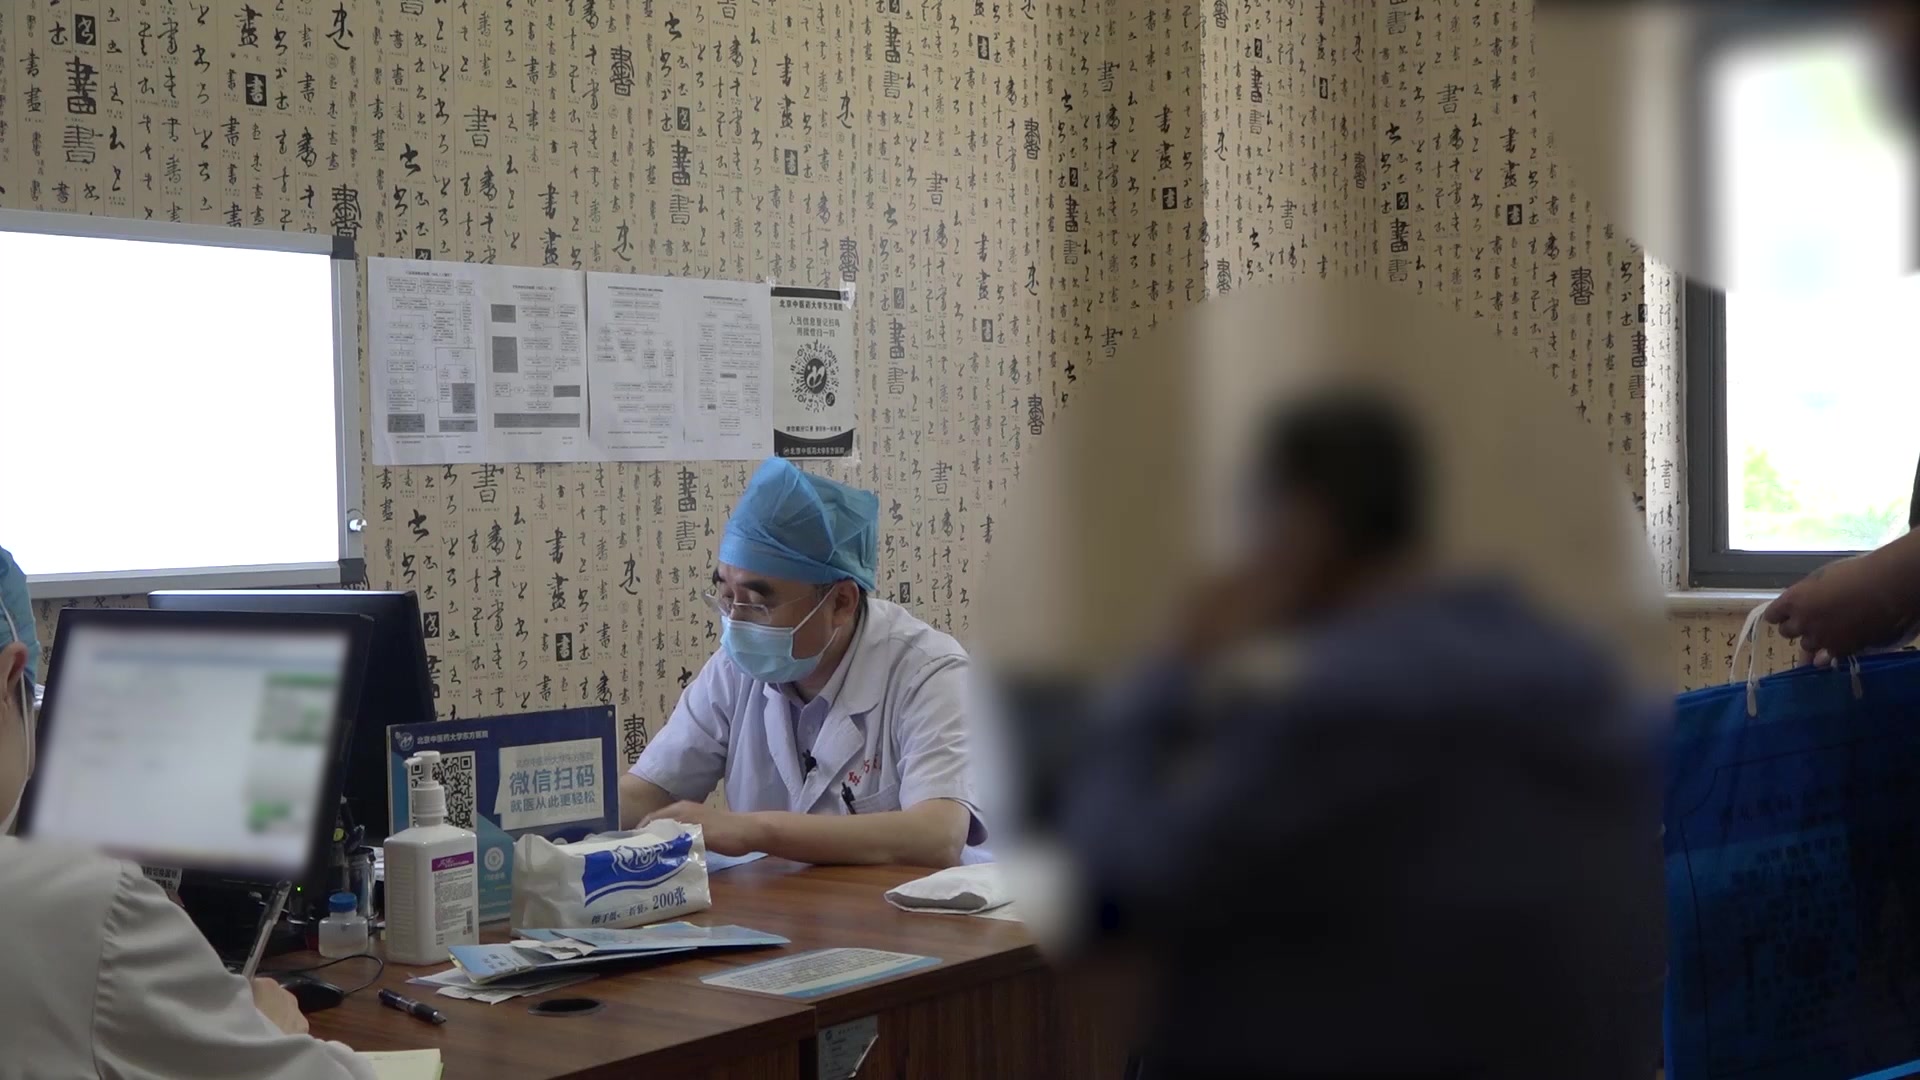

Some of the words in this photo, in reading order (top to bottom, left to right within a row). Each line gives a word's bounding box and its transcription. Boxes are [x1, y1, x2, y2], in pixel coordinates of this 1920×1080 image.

[509, 764, 595, 796] 微信扫码
[510, 791, 595, 813] 就医从此更轻松
[652, 886, 687, 910] 200张
